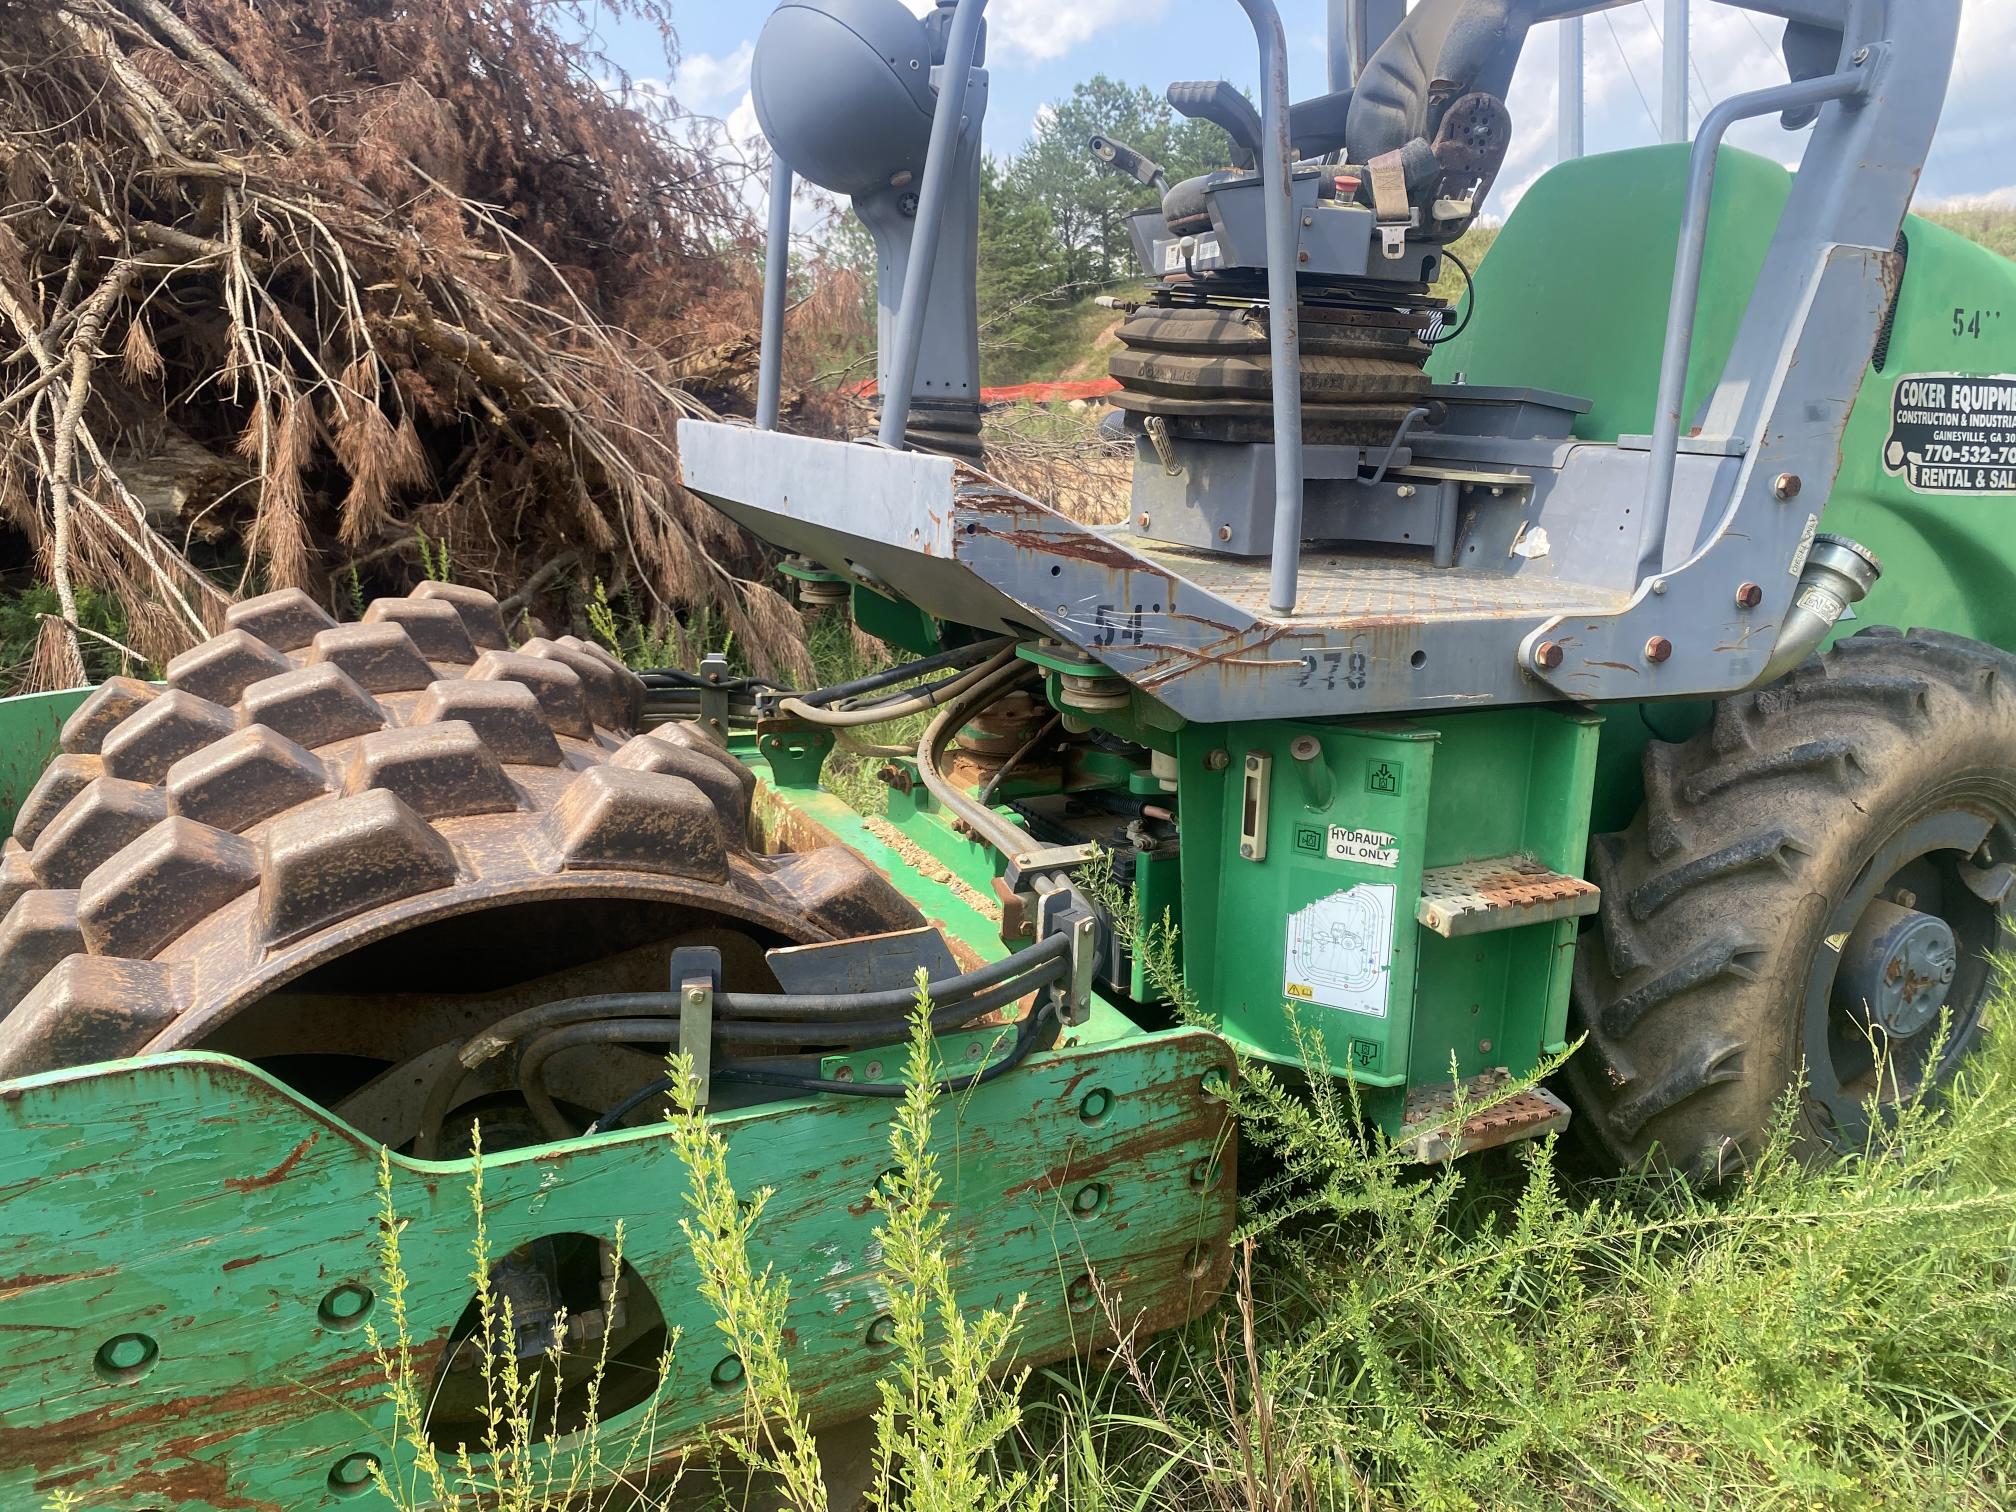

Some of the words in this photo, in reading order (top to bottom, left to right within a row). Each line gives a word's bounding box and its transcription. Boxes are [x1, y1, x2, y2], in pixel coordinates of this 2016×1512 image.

[1900, 381, 1946, 409] COKER
[1897, 410, 1959, 427] CONSTRUCTION
[1960, 414, 1968, 427] &
[1933, 430, 1988, 444] GAINESVILLE,
[1990, 432, 2002, 443] GA
[2004, 433, 2016, 444] 30
[1925, 444, 2016, 464] 770-532-70
[1921, 468, 1971, 488] RENTAL
[1975, 469, 1986, 488] &
[1989, 469, 2016, 489] SAL
[1336, 844, 1356, 856] OIL
[1359, 848, 1391, 861] ONLY
